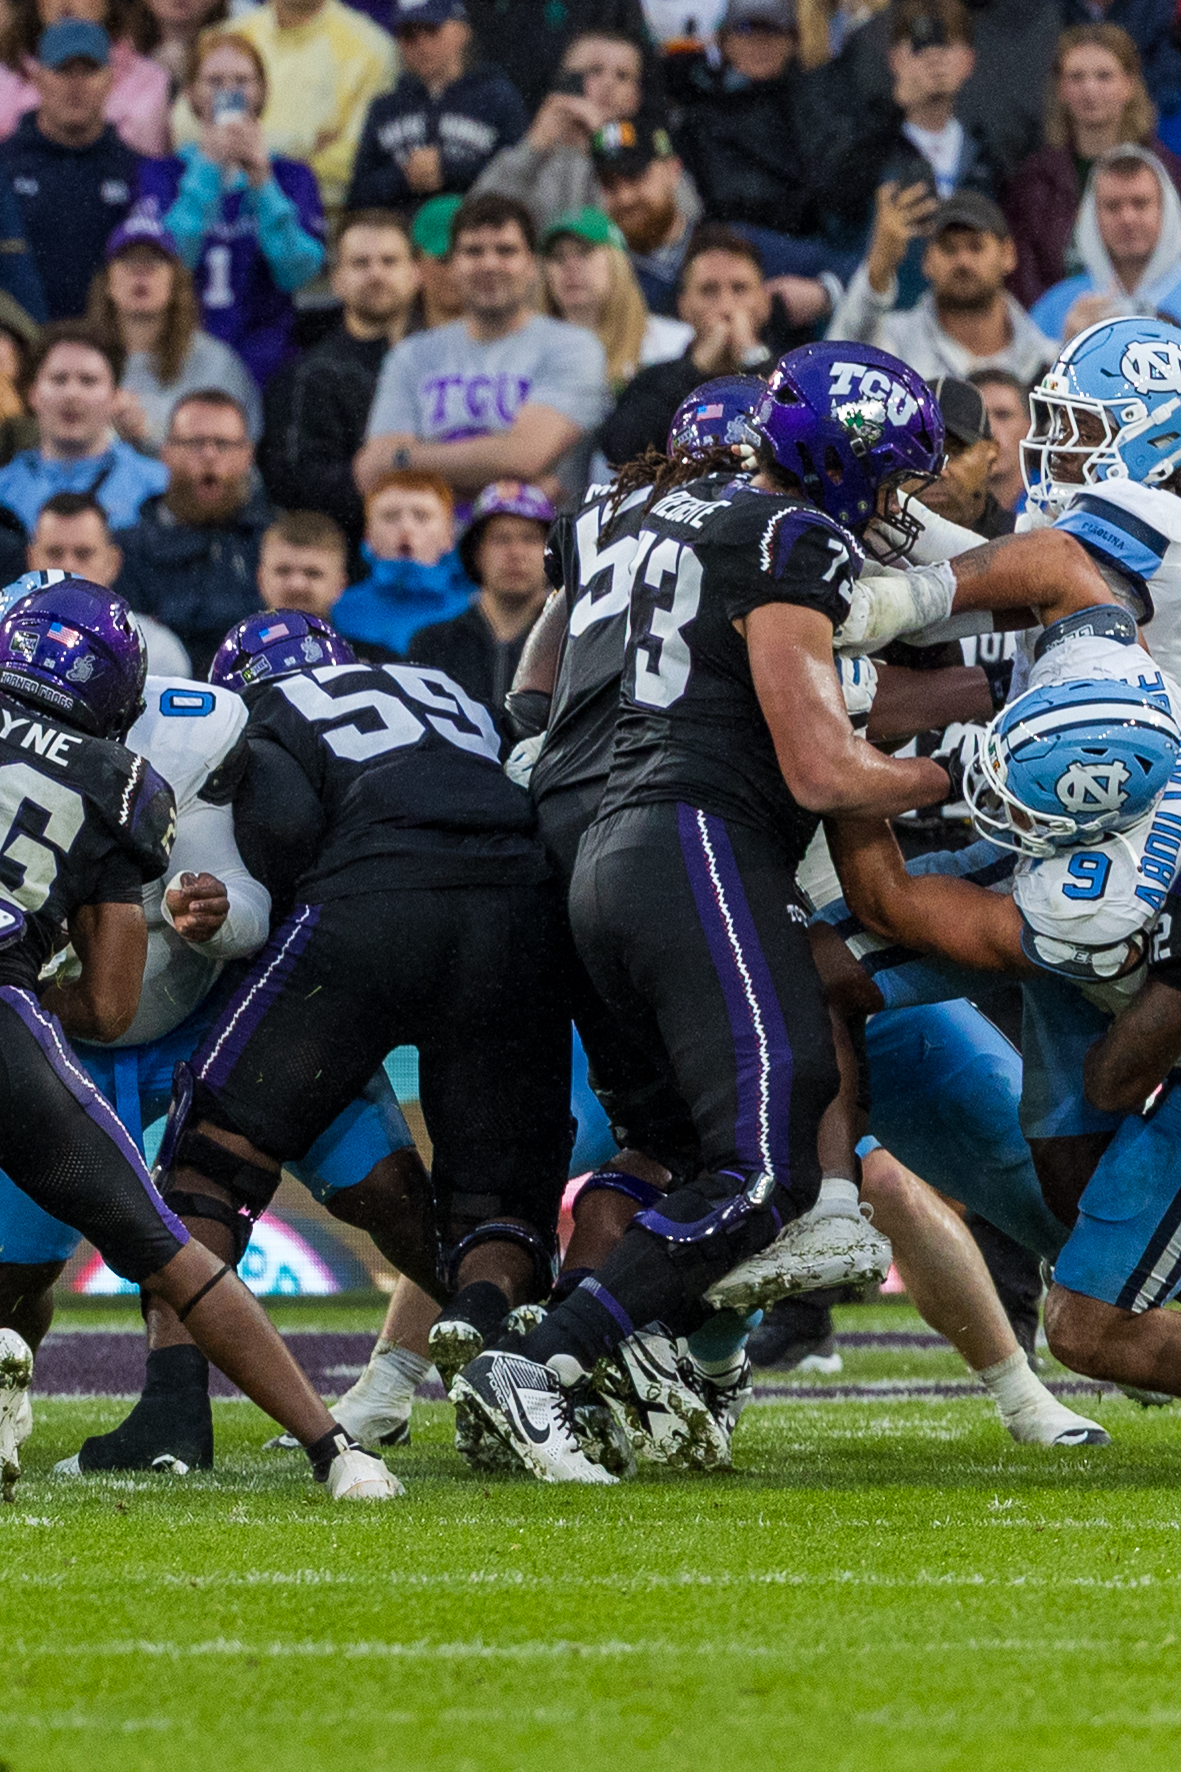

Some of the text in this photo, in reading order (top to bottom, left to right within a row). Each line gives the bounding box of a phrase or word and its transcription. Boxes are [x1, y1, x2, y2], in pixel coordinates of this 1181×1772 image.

[422, 372, 532, 427] TCU
[828, 361, 918, 428] TCU
[1081, 521, 1125, 550] COLINA
[0, 671, 74, 712] HORNED FROGS
[159, 688, 217, 717] 0
[273, 663, 502, 765] 59
[1061, 851, 1112, 901] 9
